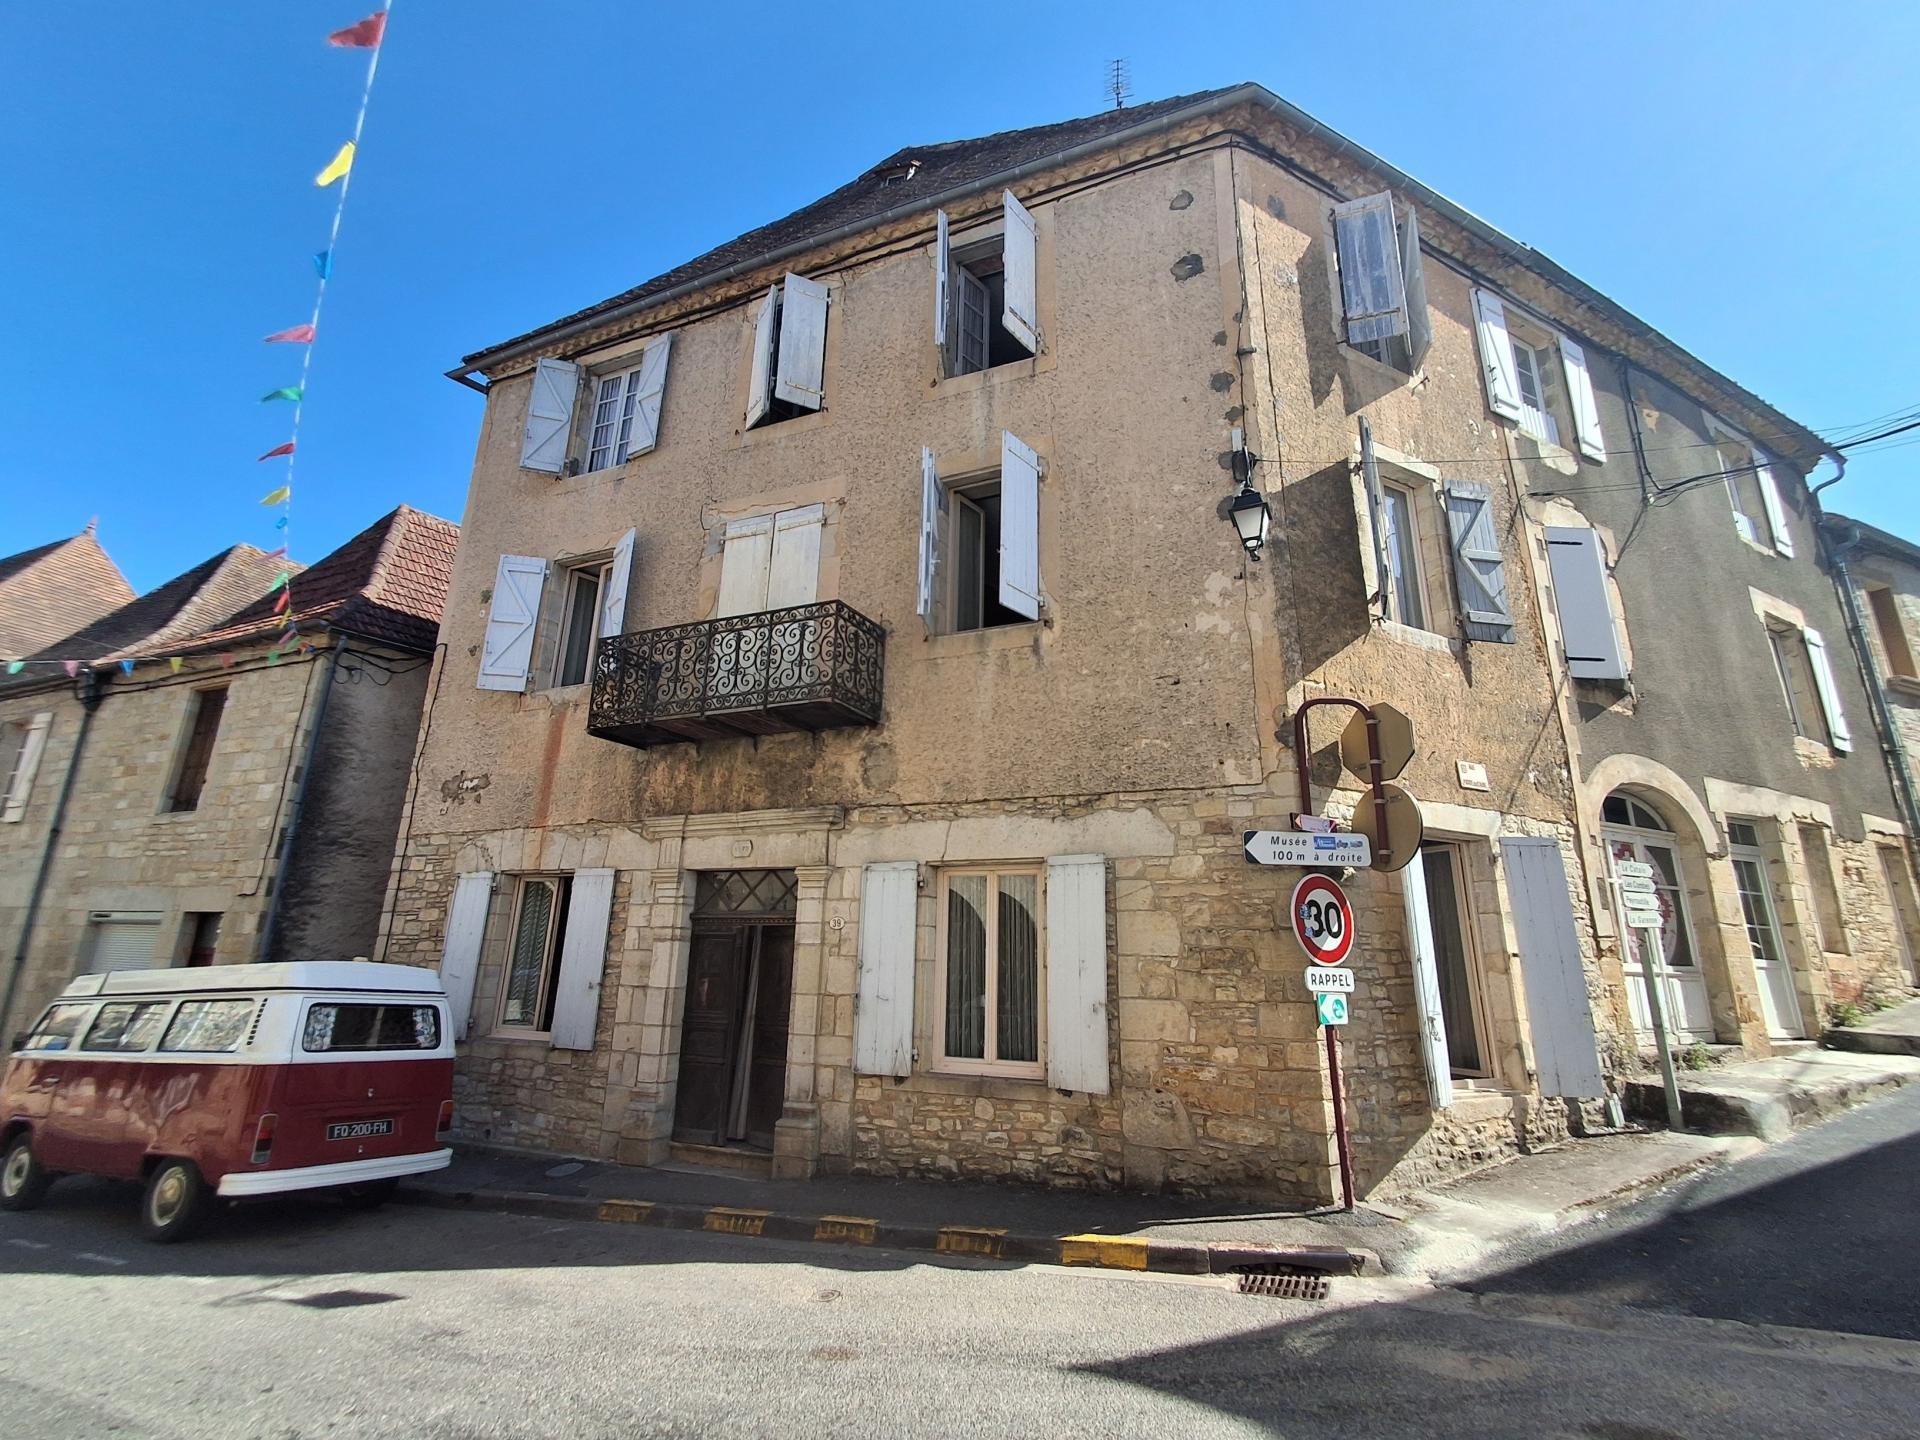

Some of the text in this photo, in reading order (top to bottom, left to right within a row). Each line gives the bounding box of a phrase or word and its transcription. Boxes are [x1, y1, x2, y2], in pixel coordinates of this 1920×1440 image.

[1270, 836, 1307, 846] Musée
[1314, 853, 1320, 861] à
[1328, 853, 1362, 862] droite
[832, 918, 842, 928] 39
[1305, 899, 1342, 939] 30
[1310, 973, 1351, 987] RAPPEL
